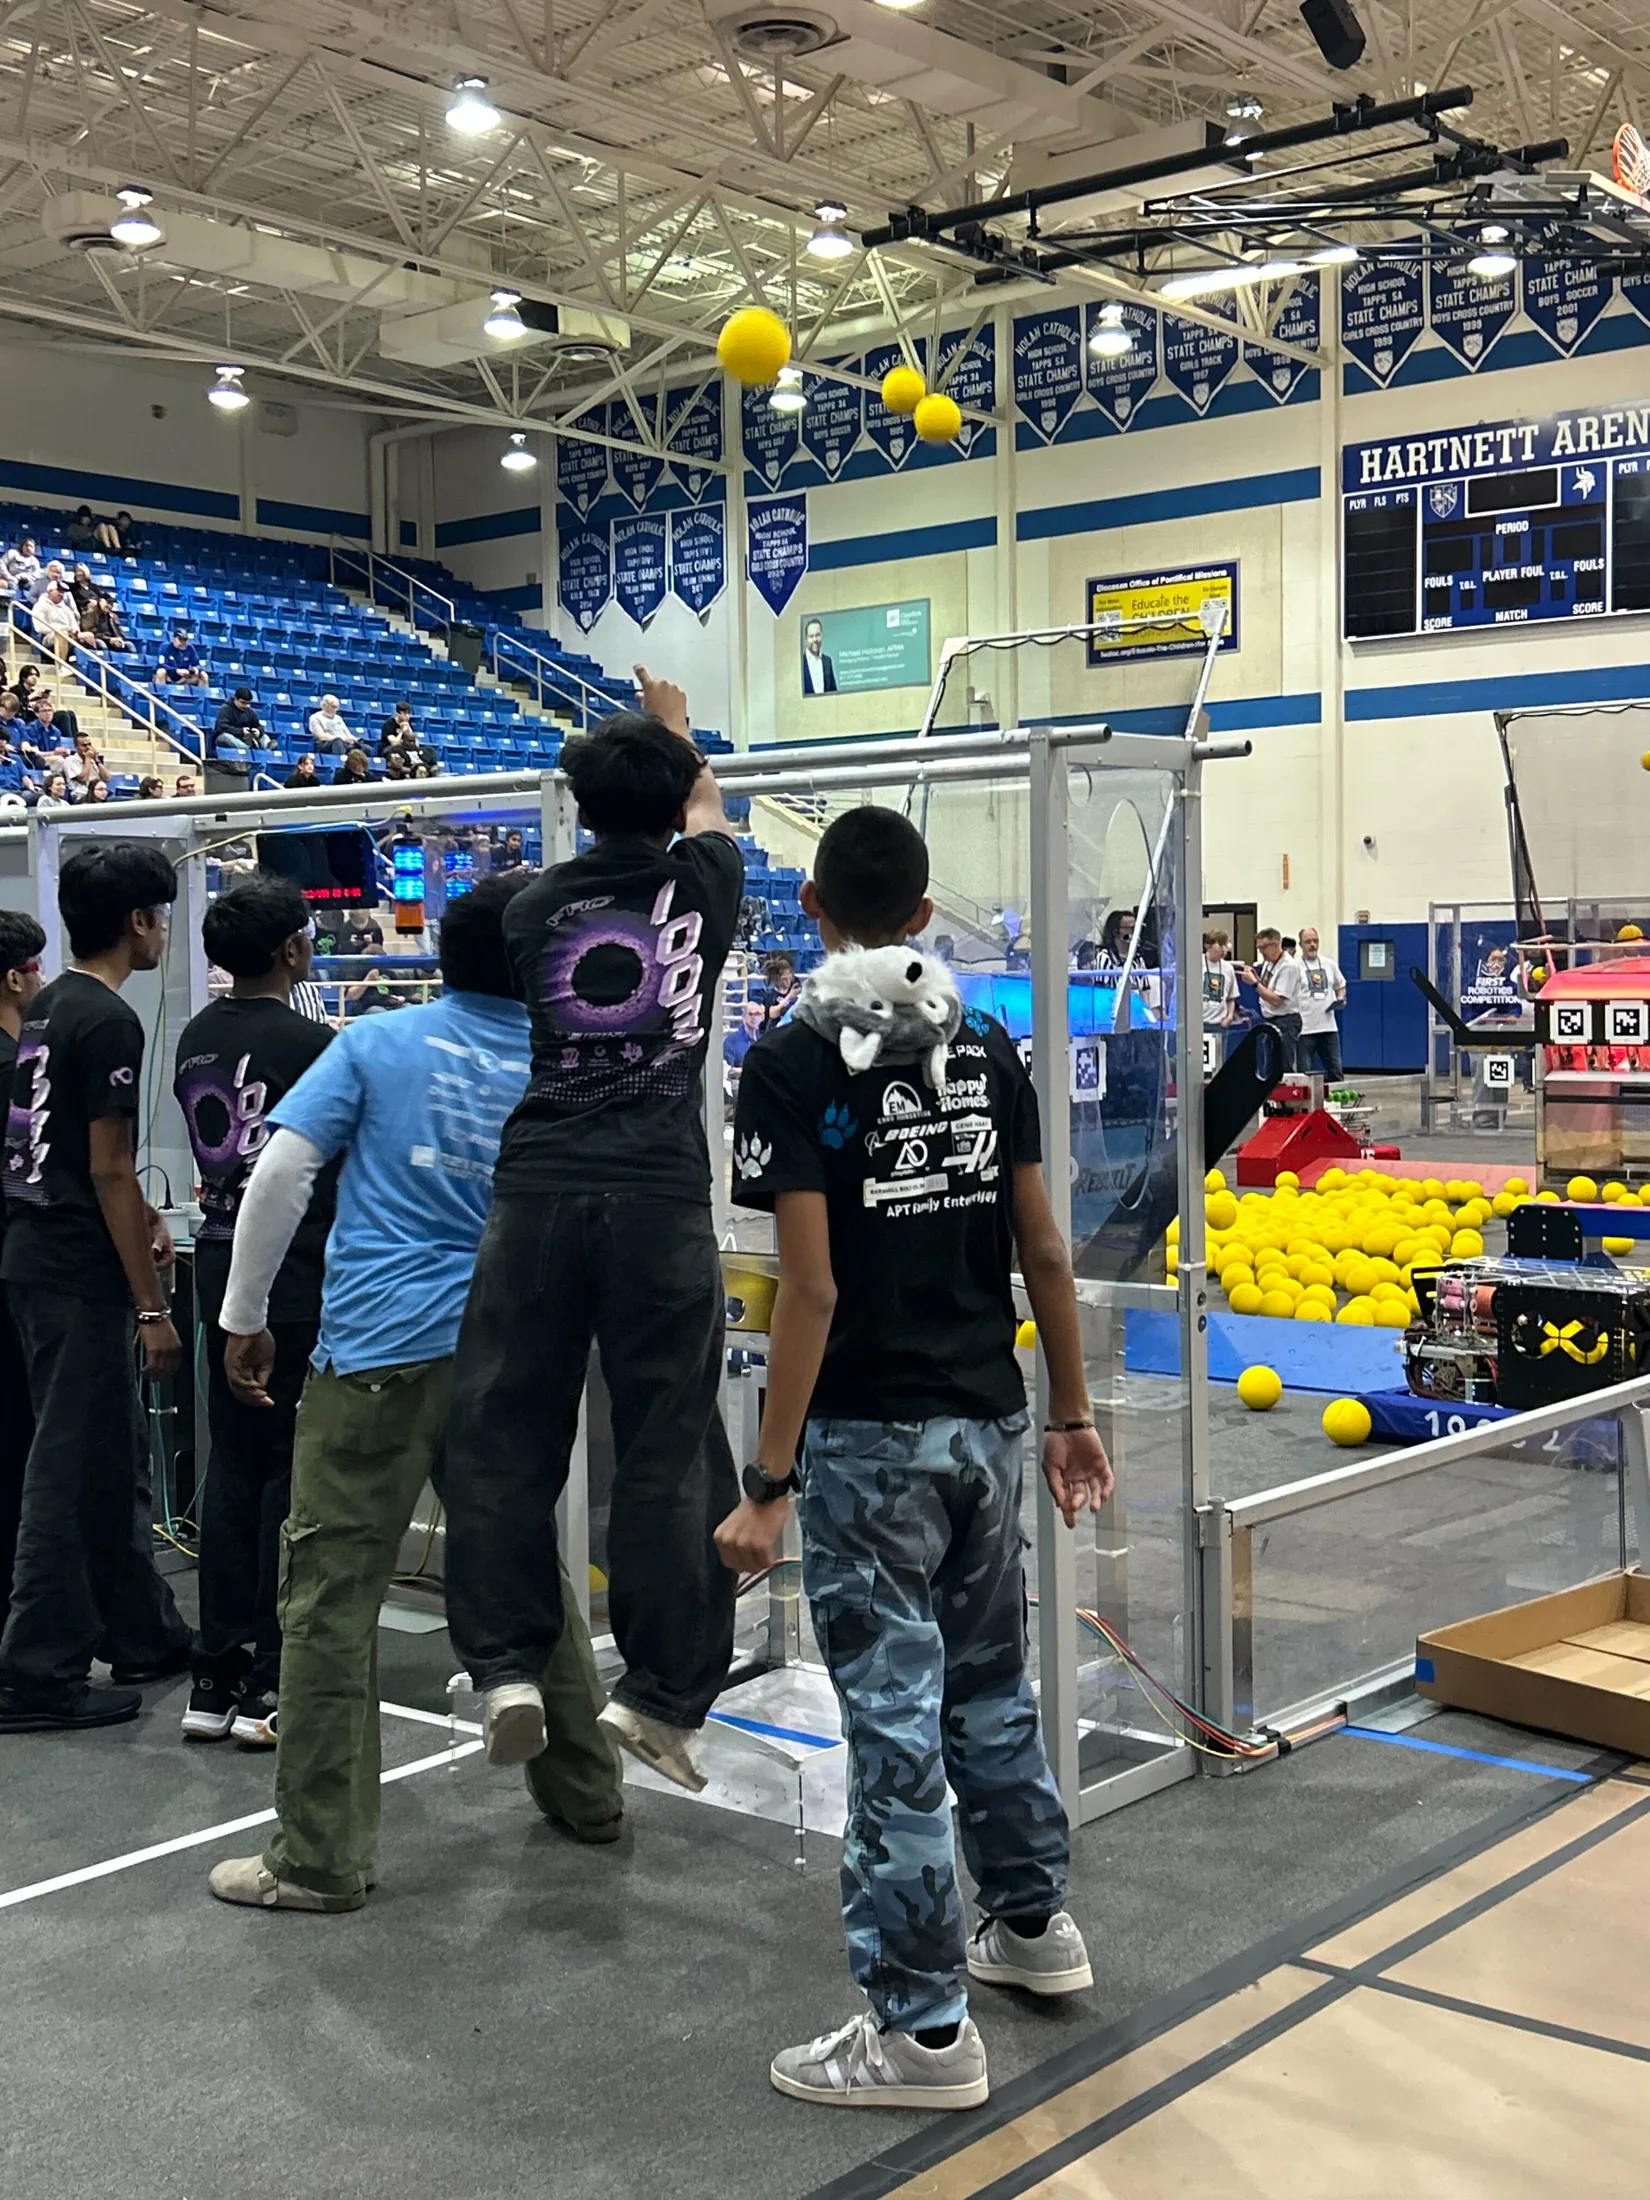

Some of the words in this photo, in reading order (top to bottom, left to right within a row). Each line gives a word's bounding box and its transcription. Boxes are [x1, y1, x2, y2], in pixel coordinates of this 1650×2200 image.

[1544, 260, 1571, 273] TAPPS
[1342, 261, 1375, 292] NOLAN
[1453, 276, 1477, 289] TAPPS
[1528, 275, 1559, 295] STATE
[1565, 266, 1598, 286] CHAM
[1358, 284, 1376, 295] HIGH
[1378, 277, 1406, 292] SCHOOL
[1363, 294, 1386, 307] TAPPS
[1392, 291, 1403, 302] 5A
[1436, 291, 1464, 310] STATE
[1470, 283, 1510, 303] CHAMPS
[1538, 294, 1559, 307] BOYS
[1566, 286, 1598, 301] SOCCER
[1291, 311, 1300, 319] 5A
[1347, 308, 1374, 327] STATE
[1380, 300, 1418, 320] CHAMPS
[1432, 312, 1451, 324] BOYS
[1453, 308, 1477, 320] CROSS
[1479, 300, 1513, 316] COUNTRY
[1557, 303, 1578, 316] 2001
[1121, 308, 1156, 331] ATHOLIC
[1183, 328, 1204, 341] TAPPS
[1279, 320, 1315, 339] CHAMPS
[1343, 330, 1364, 342] GIRLS
[1365, 324, 1389, 337] CROSS
[1391, 317, 1423, 333] COUNTRY
[1015, 326, 1041, 357] NOLAN
[1043, 322, 1080, 345] CATHOLIC
[1168, 343, 1195, 360] STATE
[1200, 336, 1233, 353] CHAMPS
[1028, 349, 1042, 359] HIGH
[1044, 343, 1067, 357] SCHOOL
[1032, 359, 1052, 371] TAPPS
[1055, 357, 1065, 367] 5A
[1090, 359, 1116, 375] STATE
[1121, 351, 1152, 368] CHAMPS
[1180, 360, 1199, 372] GIRLS
[1201, 355, 1222, 367] TRACK
[1018, 373, 1043, 389] STATE
[1047, 365, 1077, 383] CHAMPS
[1088, 378, 1104, 389] BOYS
[1106, 373, 1126, 385] CROSS
[1128, 367, 1156, 380] COUNTRY
[963, 381, 992, 398] CHAMPS
[1016, 391, 1033, 402] GIRLS
[1034, 387, 1053, 399] CROSS
[1055, 381, 1080, 394] COUNTRY
[818, 402, 835, 412] TAPPS
[807, 414, 827, 429] STATE
[831, 407, 859, 424] CHAMPS
[745, 425, 766, 440] STATE
[770, 419, 797, 435] CHAMPS
[1360, 424, 1539, 484] HARTNETT
[1551, 409, 1650, 457] AREN
[561, 460, 579, 474] STATE
[1619, 461, 1638, 474] PLYR
[1350, 499, 1367, 510] PLYR
[1374, 496, 1386, 507] FLS
[1396, 492, 1409, 504] PTS
[749, 511, 772, 532] NOLAN
[772, 508, 805, 526] CATHOLIC
[1496, 520, 1529, 535] PERIOD
[753, 548, 771, 560] STATE
[773, 543, 803, 558] CHAMPS
[674, 560, 693, 576] STATE
[695, 558, 722, 572] CHAMPS
[1483, 568, 1517, 582] PLAYER
[1521, 565, 1545, 577] FOUL
[1574, 558, 1605, 572] FOULS
[562, 579, 580, 591] STATE
[617, 571, 636, 584] STATE
[1097, 582, 1128, 592] Diocesan
[1129, 579, 1150, 588] Office
[1152, 577, 1159, 585] of
[1161, 572, 1194, 584] Pontifical
[1195, 569, 1227, 579] Missions
[1424, 576, 1453, 589] FOULS
[1132, 594, 1170, 611] Educate
[1173, 594, 1189, 605] the
[1573, 602, 1603, 614] SCORE
[1424, 616, 1452, 630] SCORE
[1496, 610, 1528, 622] MATCH
[1476, 977, 1506, 986] FIRST
[1460, 995, 1521, 1004] COMPETITION
[1468, 987, 1513, 995] ROBOTICS
[956, 1045, 987, 1058] PACK
[889, 1101, 906, 1114] EM
[884, 1121, 948, 1141] BOEING
[887, 1204, 911, 1218] APT
